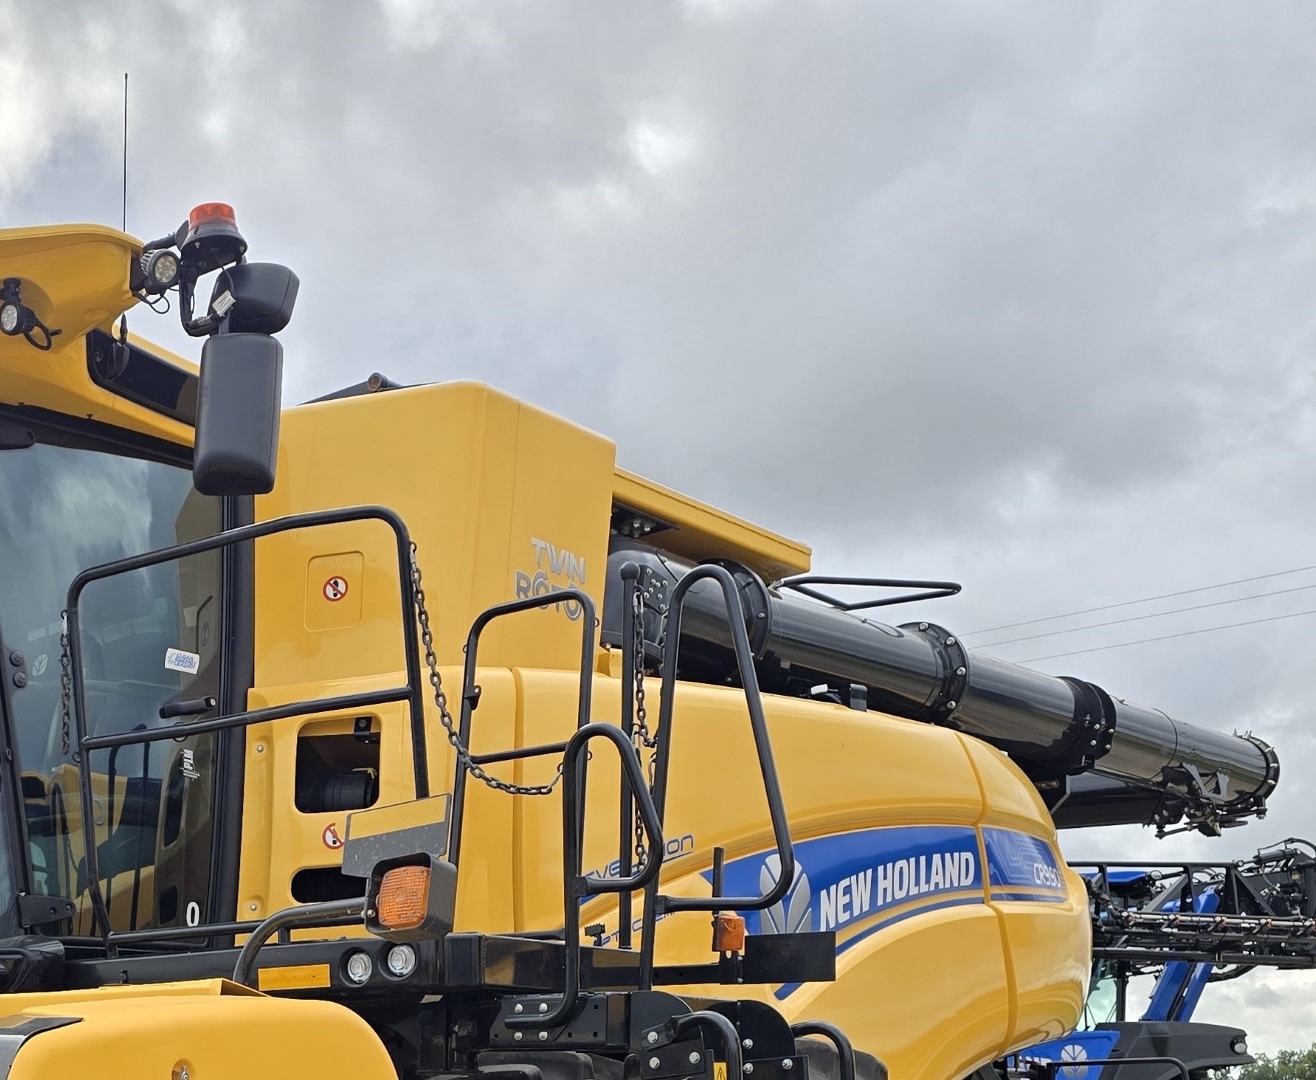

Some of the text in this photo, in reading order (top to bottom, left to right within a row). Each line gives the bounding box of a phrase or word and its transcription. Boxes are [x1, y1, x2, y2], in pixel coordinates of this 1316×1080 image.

[531, 537, 586, 585] TWIN
[515, 569, 584, 621] ROTO
[820, 851, 975, 931] NEW HOLLAND
